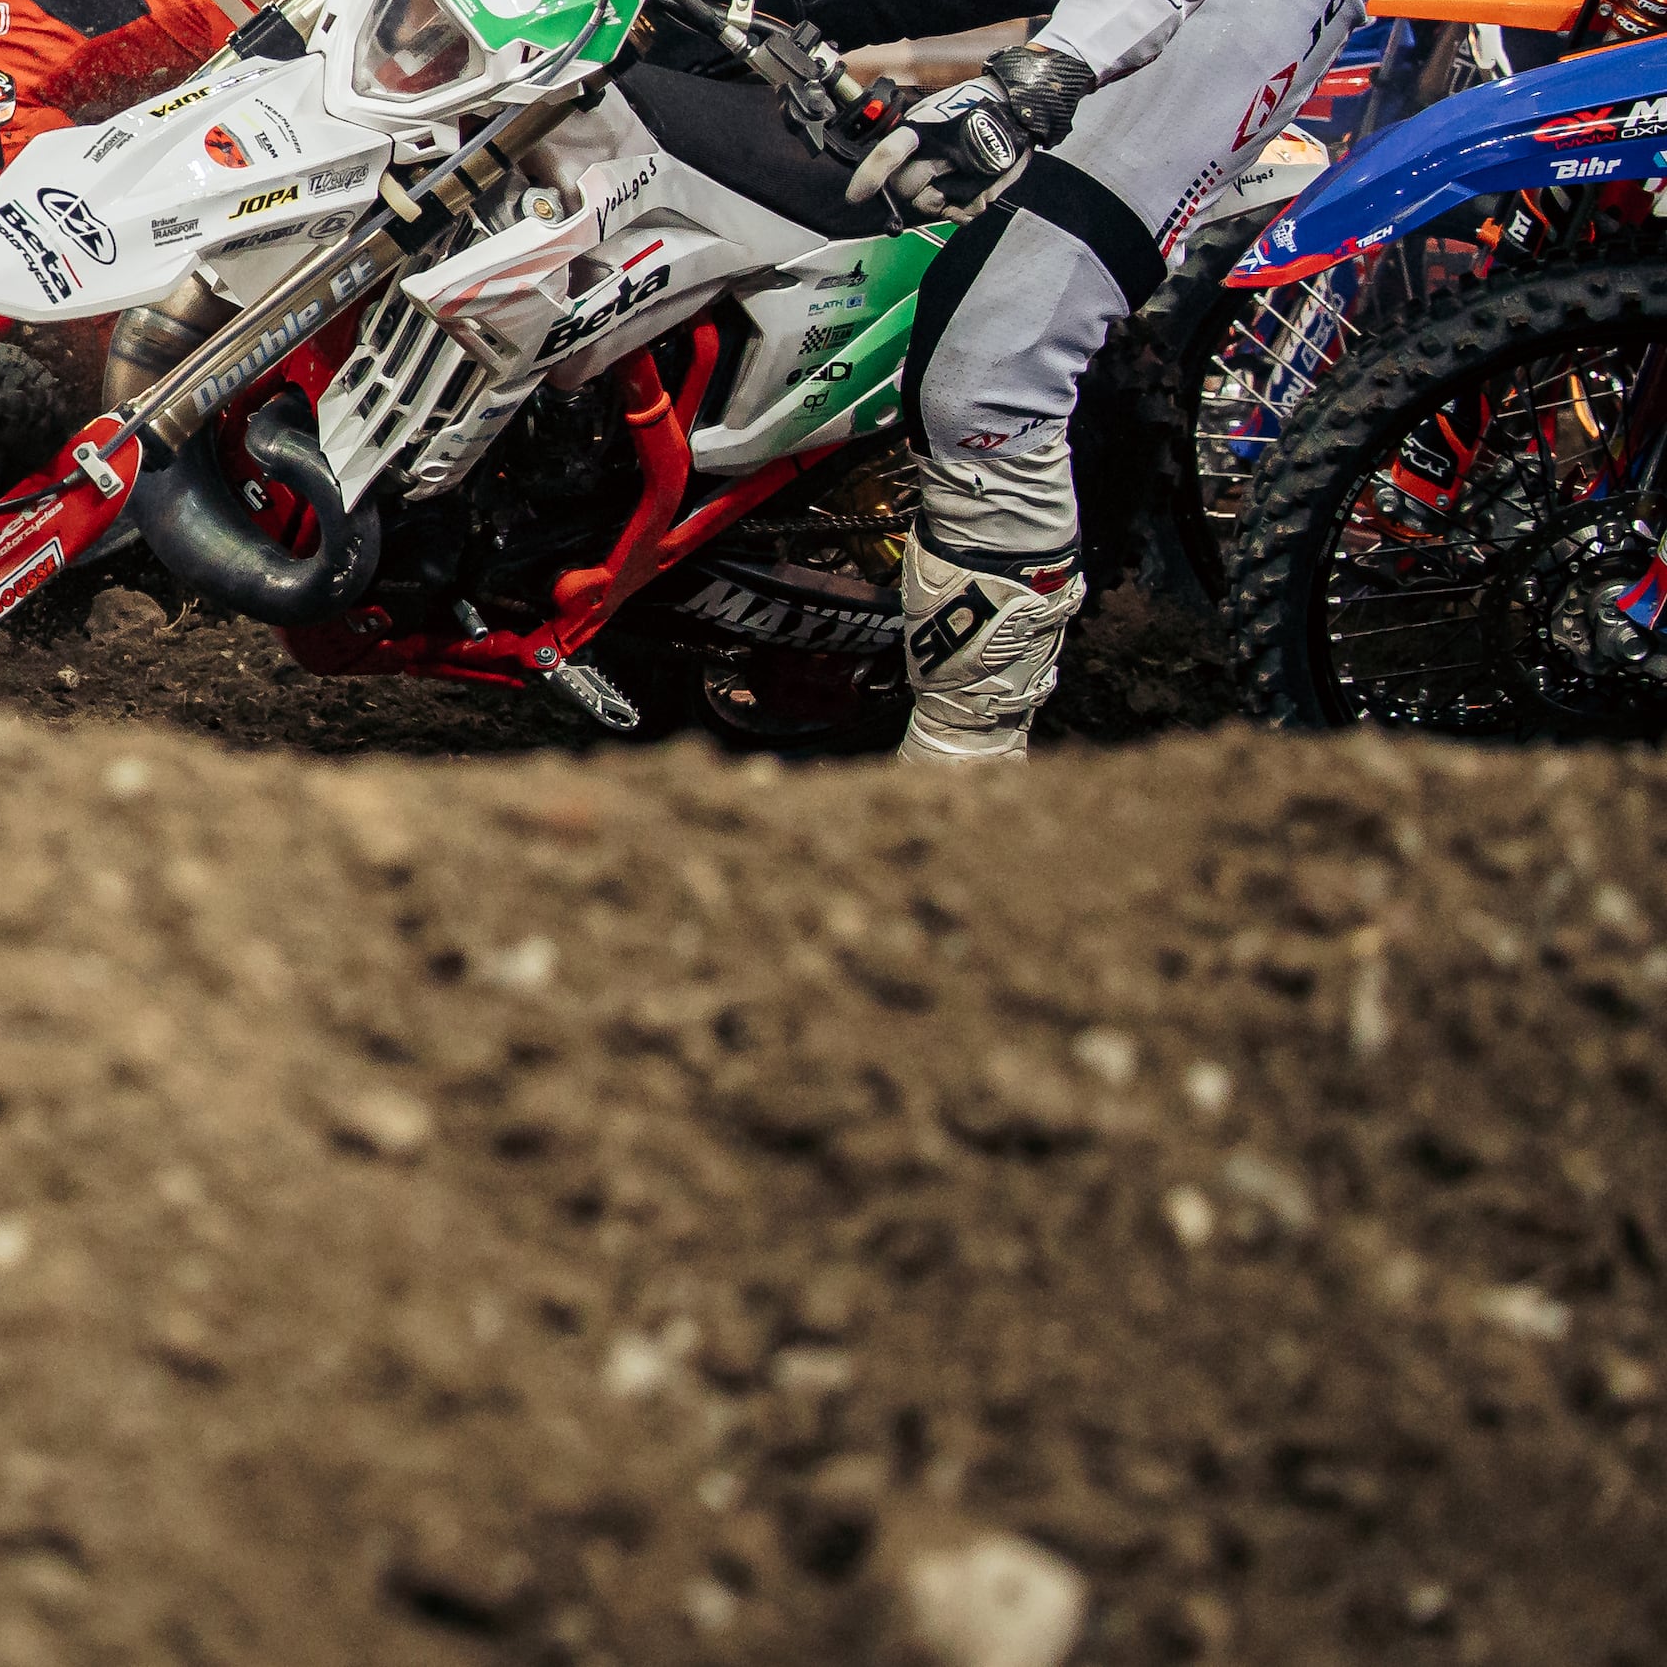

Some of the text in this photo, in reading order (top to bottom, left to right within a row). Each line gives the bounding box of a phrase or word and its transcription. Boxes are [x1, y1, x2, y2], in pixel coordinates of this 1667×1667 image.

[1550, 157, 1622, 180] Bihr
[228, 184, 301, 220] JOPA
[534, 264, 671, 363] Beta
